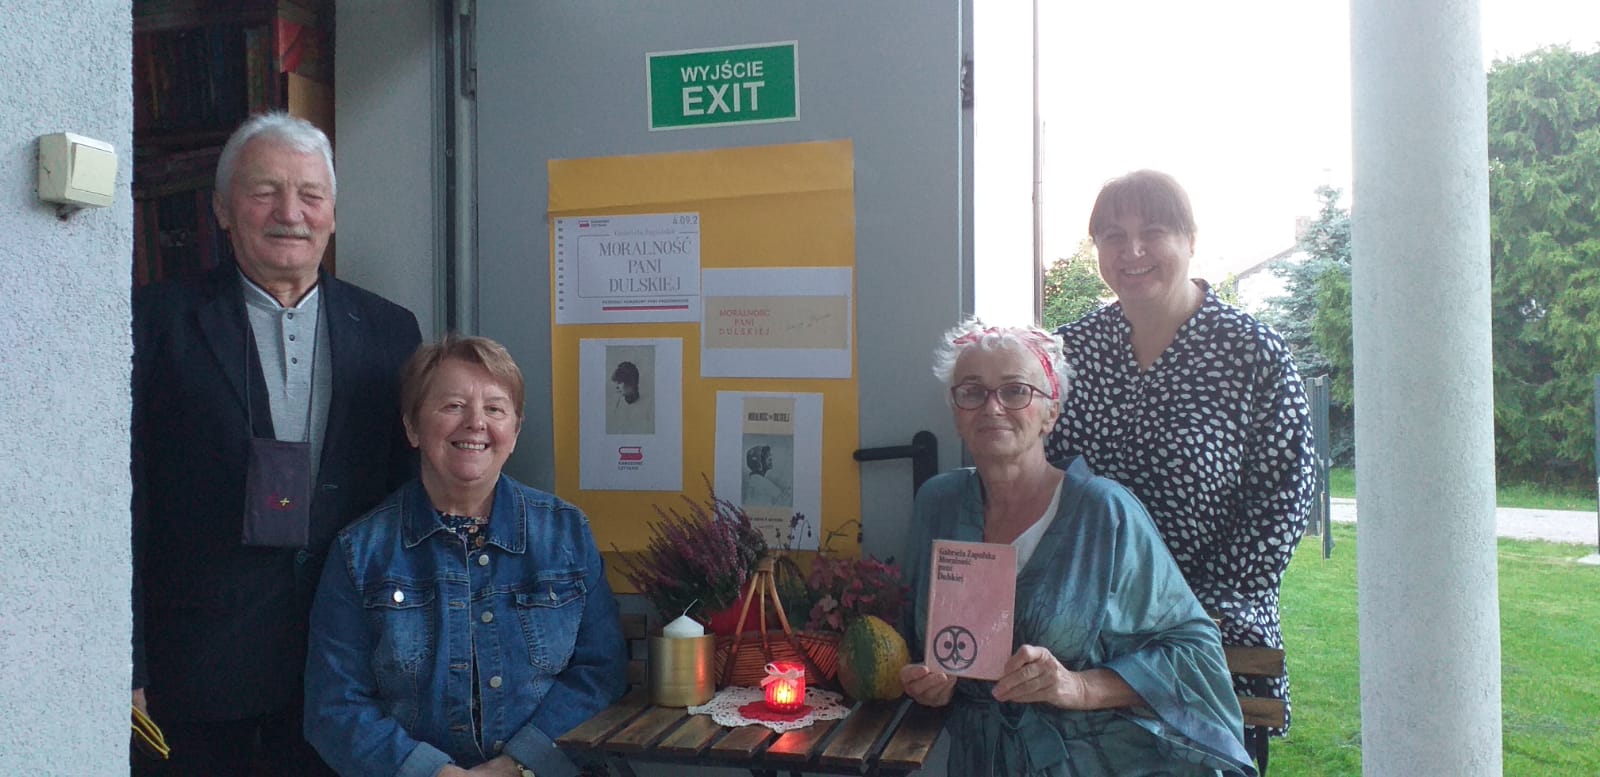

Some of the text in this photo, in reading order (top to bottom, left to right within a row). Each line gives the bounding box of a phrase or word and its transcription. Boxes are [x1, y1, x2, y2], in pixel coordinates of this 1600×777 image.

[680, 60, 764, 83] WYJŚCIE
[682, 81, 765, 116] EXIT
[599, 236, 692, 257] MORALNOŚĆ
[628, 258, 662, 274] PANI
[609, 277, 681, 293] DULSKIEJ
[719, 327, 770, 336] DULSKIEJ
